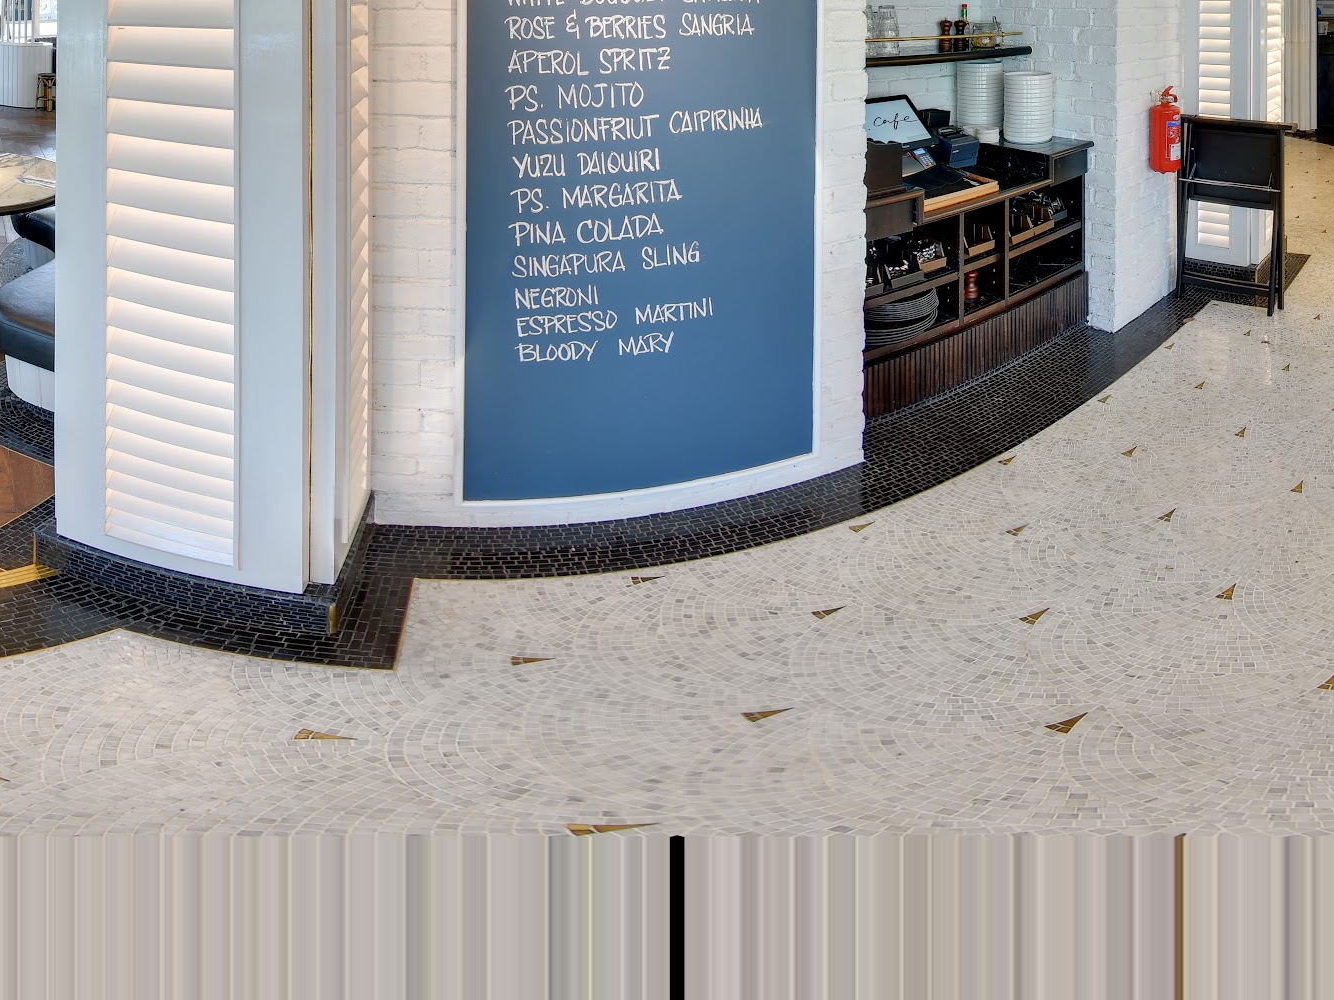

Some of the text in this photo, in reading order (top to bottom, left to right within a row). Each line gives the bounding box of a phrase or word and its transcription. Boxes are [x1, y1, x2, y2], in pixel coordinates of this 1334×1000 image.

[504, 9, 755, 40] ROSE & BERRIES SANGRIA
[508, 47, 670, 75] APEROL SPRITZ
[505, 81, 644, 112] PS. MOJITO
[507, 107, 762, 145] PASSIONFRIUT CAIPIRINHA
[512, 148, 660, 178] YUZU DAIQUIRI
[510, 179, 682, 213] PS. MARGARITA
[508, 213, 664, 246] PINA COLADA
[512, 241, 699, 277] SINGAPURA SLING
[515, 284, 598, 309] NEGRONI
[516, 297, 713, 337] ESPRESSO MARTINI
[514, 331, 674, 362] BLOODY MARY
